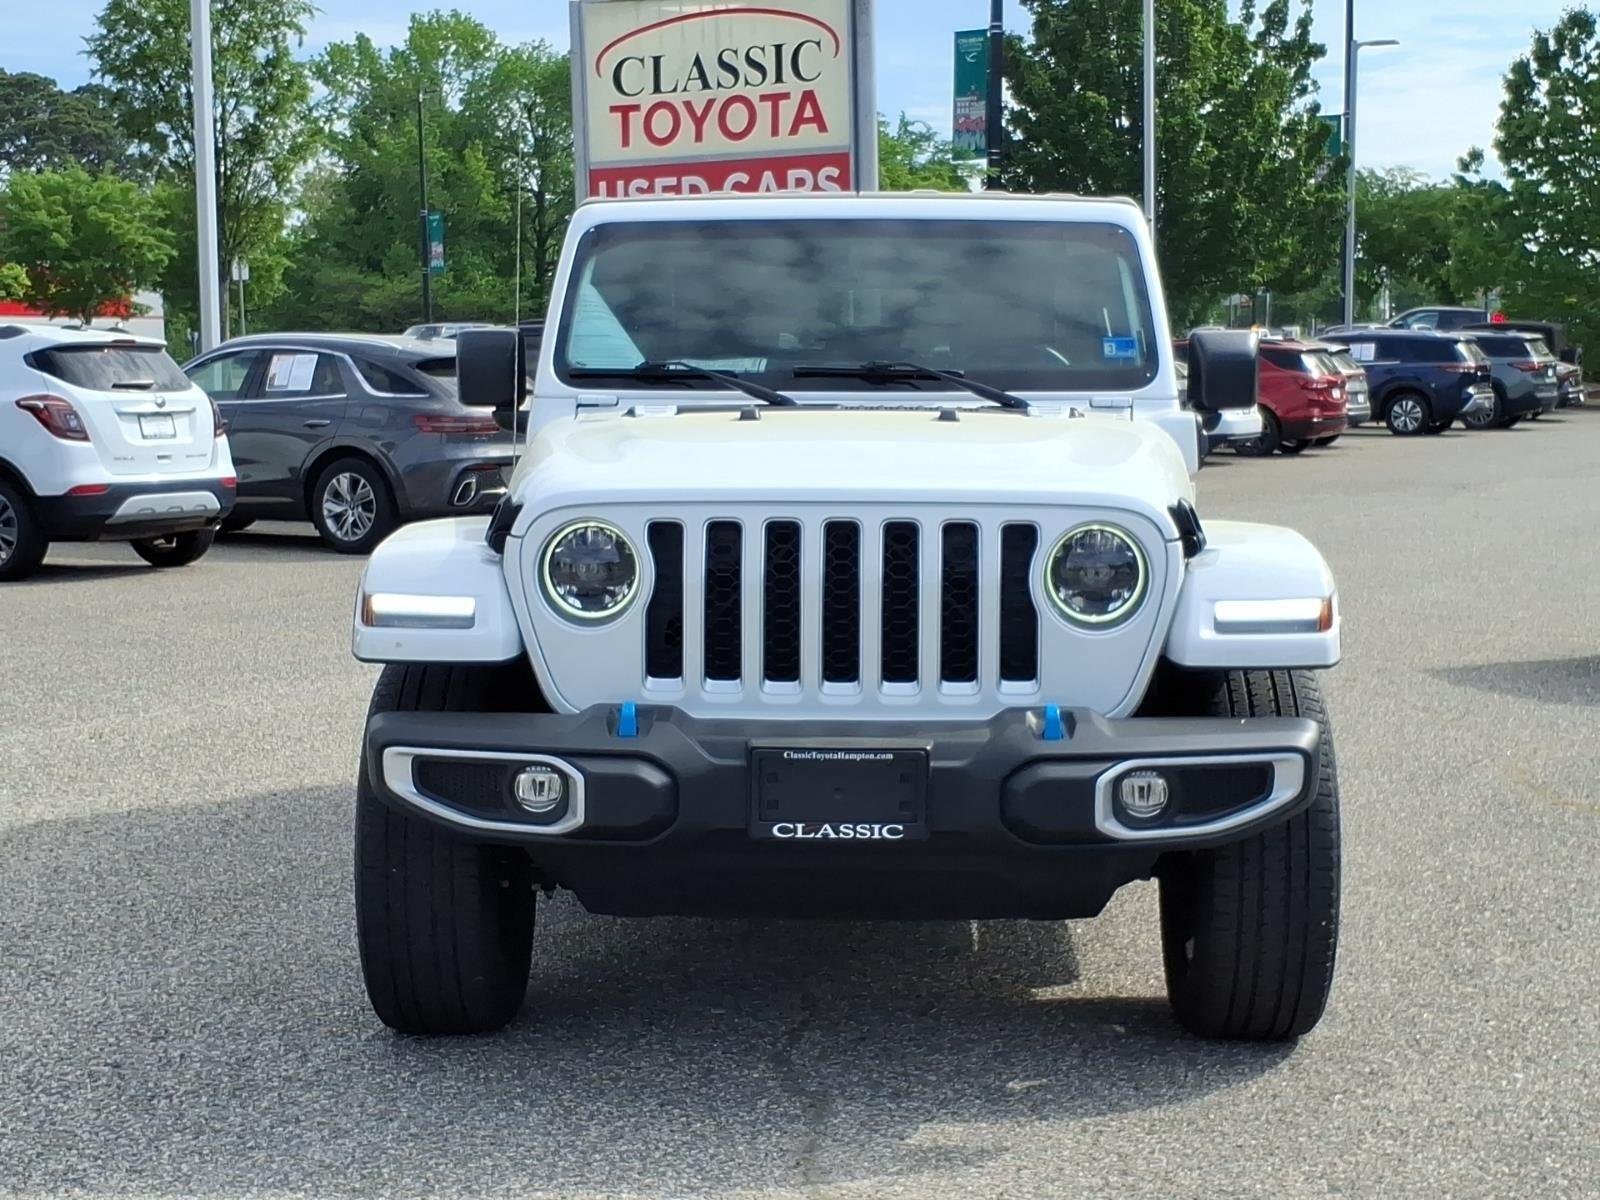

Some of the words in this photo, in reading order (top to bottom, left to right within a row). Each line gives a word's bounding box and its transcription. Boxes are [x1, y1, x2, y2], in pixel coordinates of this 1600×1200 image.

[612, 39, 823, 97] CLASSIC
[609, 90, 829, 148] TOYOTA
[783, 751, 893, 761] ClassicToyotaHampton.com
[772, 823, 904, 839] CLASSIC
